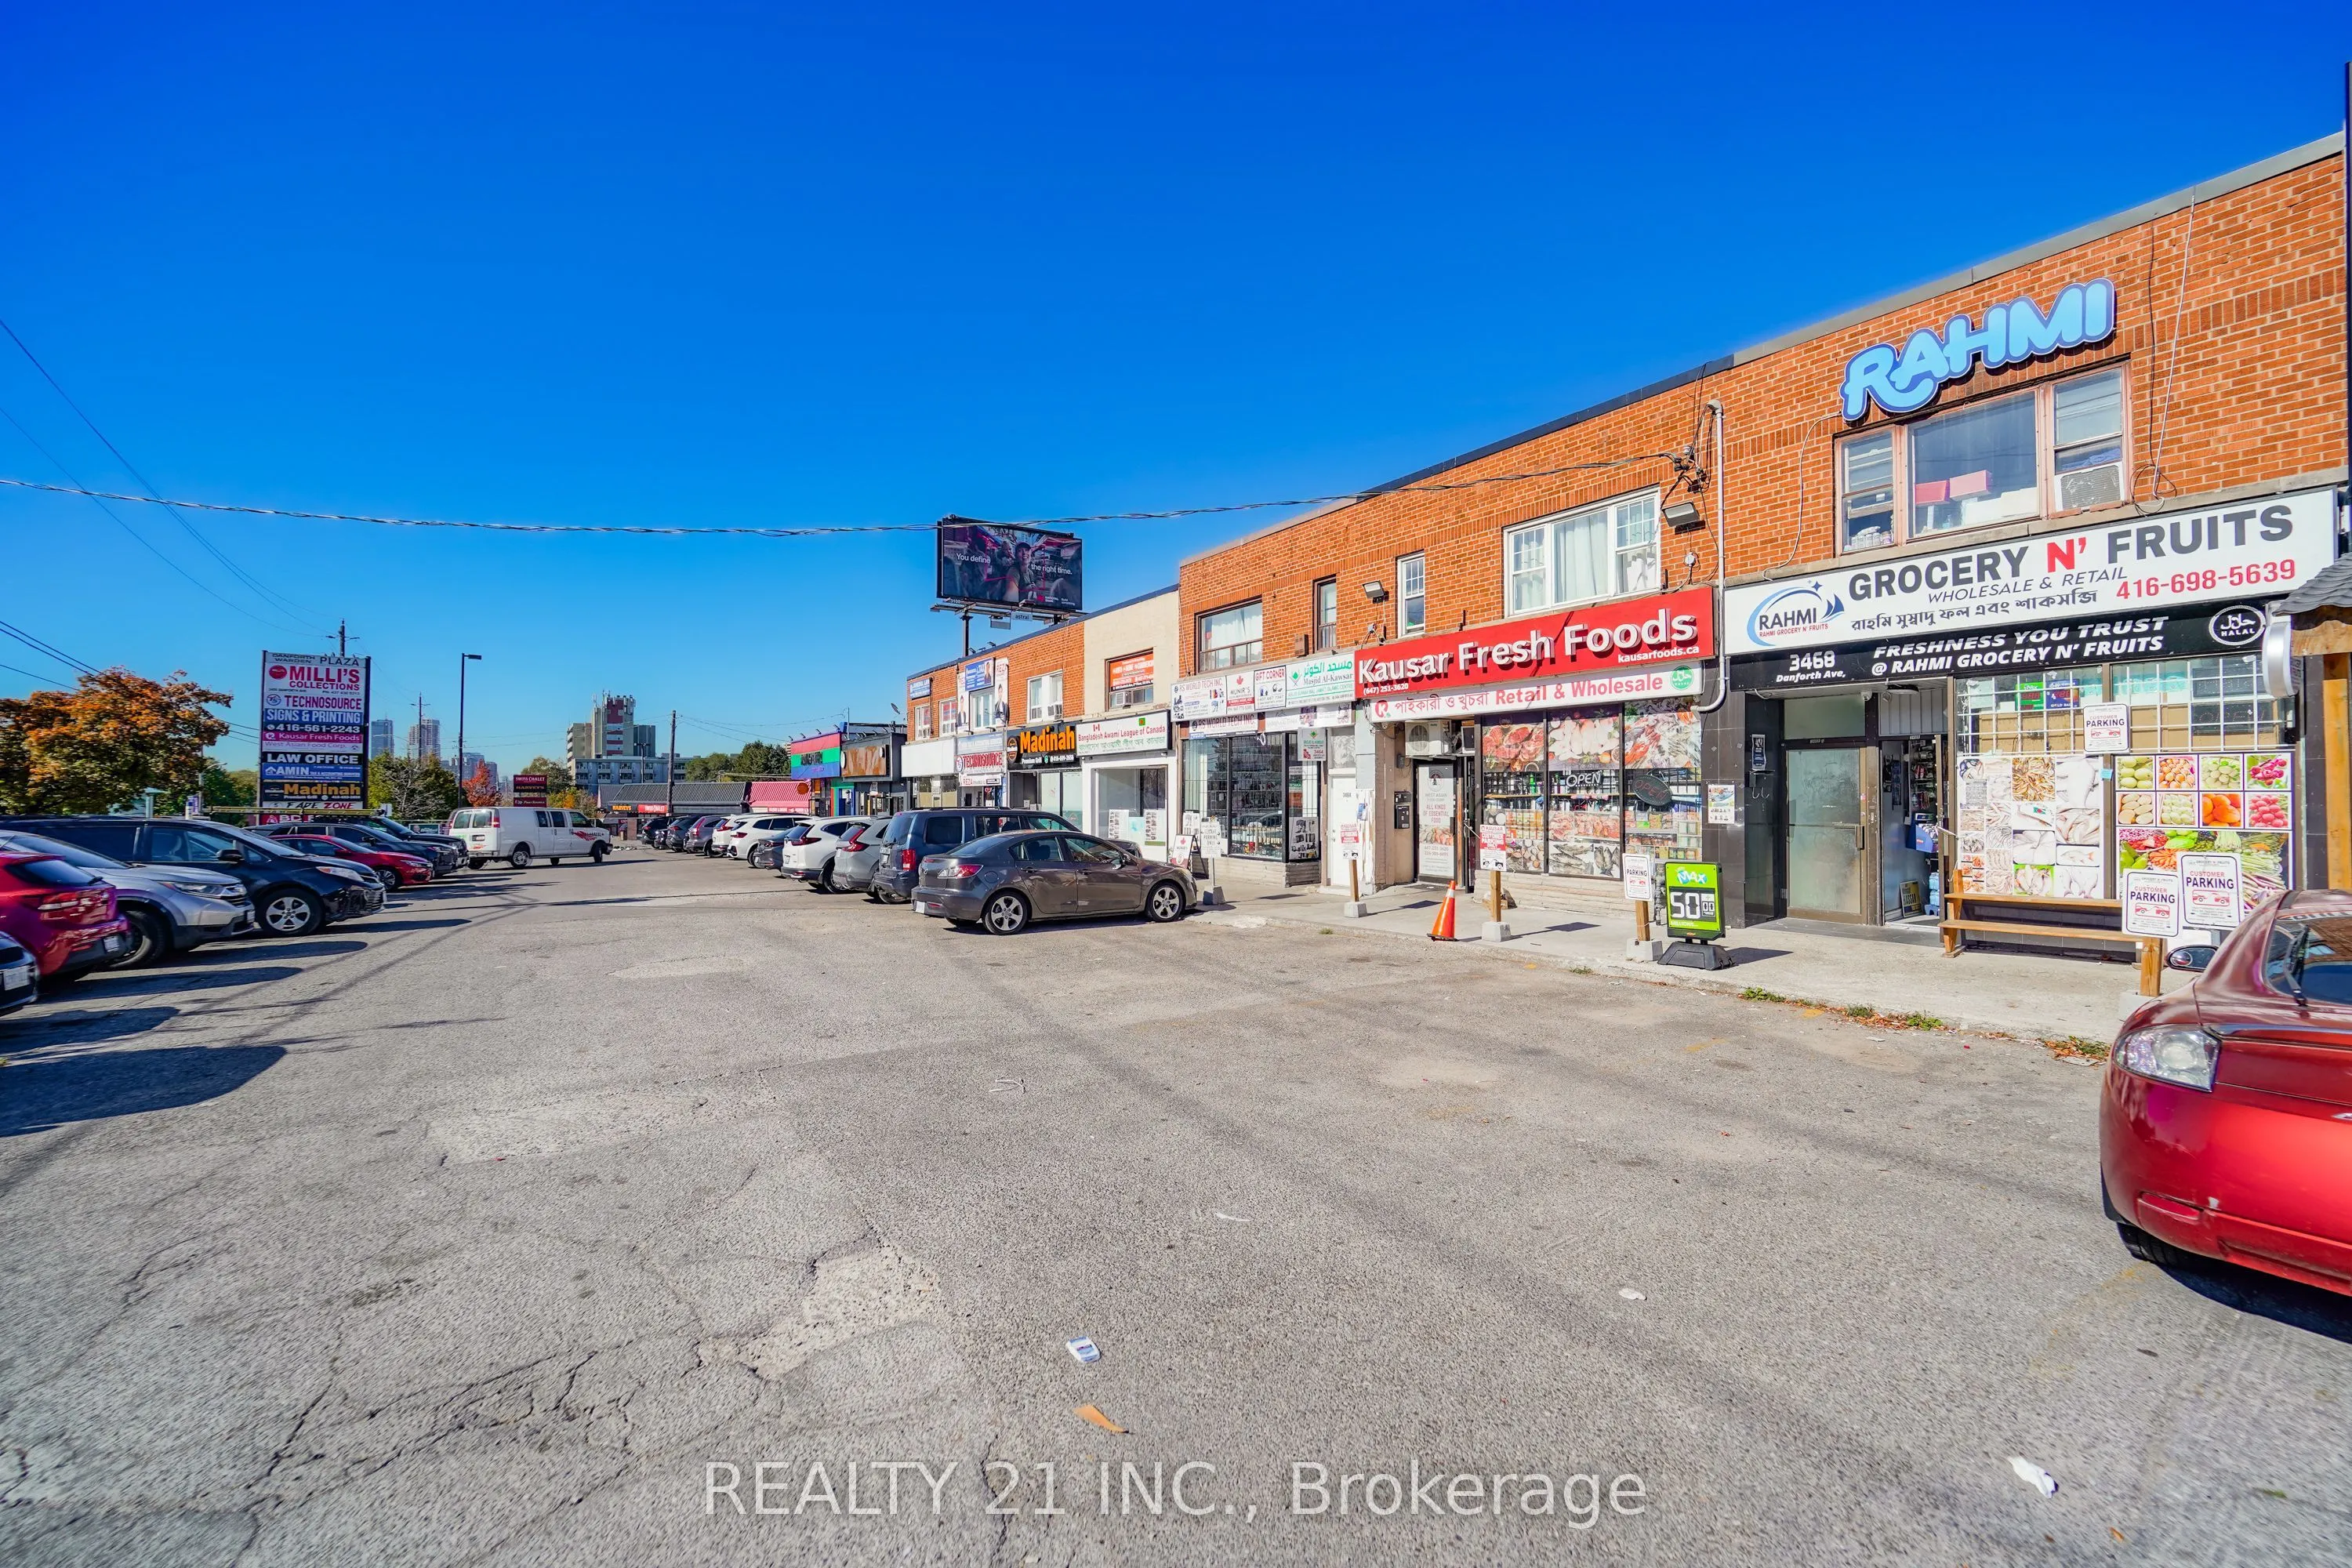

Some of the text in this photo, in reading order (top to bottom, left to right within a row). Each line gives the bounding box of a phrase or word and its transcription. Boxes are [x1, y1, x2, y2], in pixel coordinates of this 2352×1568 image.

[1841, 278, 2114, 419] RAHMI
[971, 554, 991, 564] define
[1849, 505, 2293, 601] GROCERY N' FRUITS
[1043, 564, 1057, 574] right
[1058, 566, 1073, 575] time.
[1929, 567, 2128, 604] WHOLESALE & RETAIL
[2117, 559, 2296, 600] 416-698-5639
[1759, 608, 1817, 630] RAHMI
[1851, 612, 1892, 631] রাহমি
[1940, 606, 1969, 620] ফল
[1975, 601, 2010, 616] এবং
[1777, 627, 1802, 636] GROCERY
[1809, 623, 1828, 632] FRUITS
[2221, 628, 2256, 637] HALAL
[1873, 616, 2169, 659] FRESHNESS YOU TRUST
[1359, 608, 1697, 687] Kausar Fresh Foods
[1618, 645, 1700, 663] kausarfoods.ca
[320, 656, 359, 666] PLAZA
[1789, 650, 1835, 672] 3468
[1871, 636, 2164, 676] @ RAHMI GROCERY N' FRUITS
[1327, 659, 1353, 673] مسجد
[289, 666, 360, 684] MILLI'S
[1255, 668, 1285, 681] GIFT CORNER
[1303, 673, 1352, 686] Masjid Al-Kawsar
[1776, 670, 1846, 683] Danforth Ave,
[289, 681, 360, 691] COLLECTIONS
[1186, 681, 1201, 690] WORLD
[1201, 680, 1213, 688] TECH
[1363, 683, 1409, 696] (647) 251-3620
[1495, 672, 1663, 706] Retail & Wholesale
[285, 695, 362, 710] TECHNOSOURCE
[1446, 698, 1454, 707] ও
[1458, 692, 1489, 710] খুচরা
[267, 709, 361, 724] SIGNS & PRINTING
[1198, 719, 1206, 729] RS
[1207, 717, 1226, 728] WORLD
[1227, 714, 1243, 726] TECH
[2086, 718, 2125, 728] PARKING
[276, 724, 361, 733] 416-561-2243
[1078, 732, 1103, 742] Bangladesh
[1120, 730, 1138, 739] League
[1146, 726, 1166, 735] Canada
[1020, 725, 1075, 753] Madinah
[267, 753, 358, 764] LAW OFFICE
[963, 752, 1003, 768] TECHNOSOURCE
[276, 766, 310, 775] AMIN
[1566, 770, 1602, 787] OPEN
[284, 784, 361, 795] Madinah
[1635, 779, 1668, 801] OPEN
[2186, 877, 2234, 889] PARKING
[2130, 891, 2176, 903] PARKING
[1671, 891, 1715, 919] 50 00
